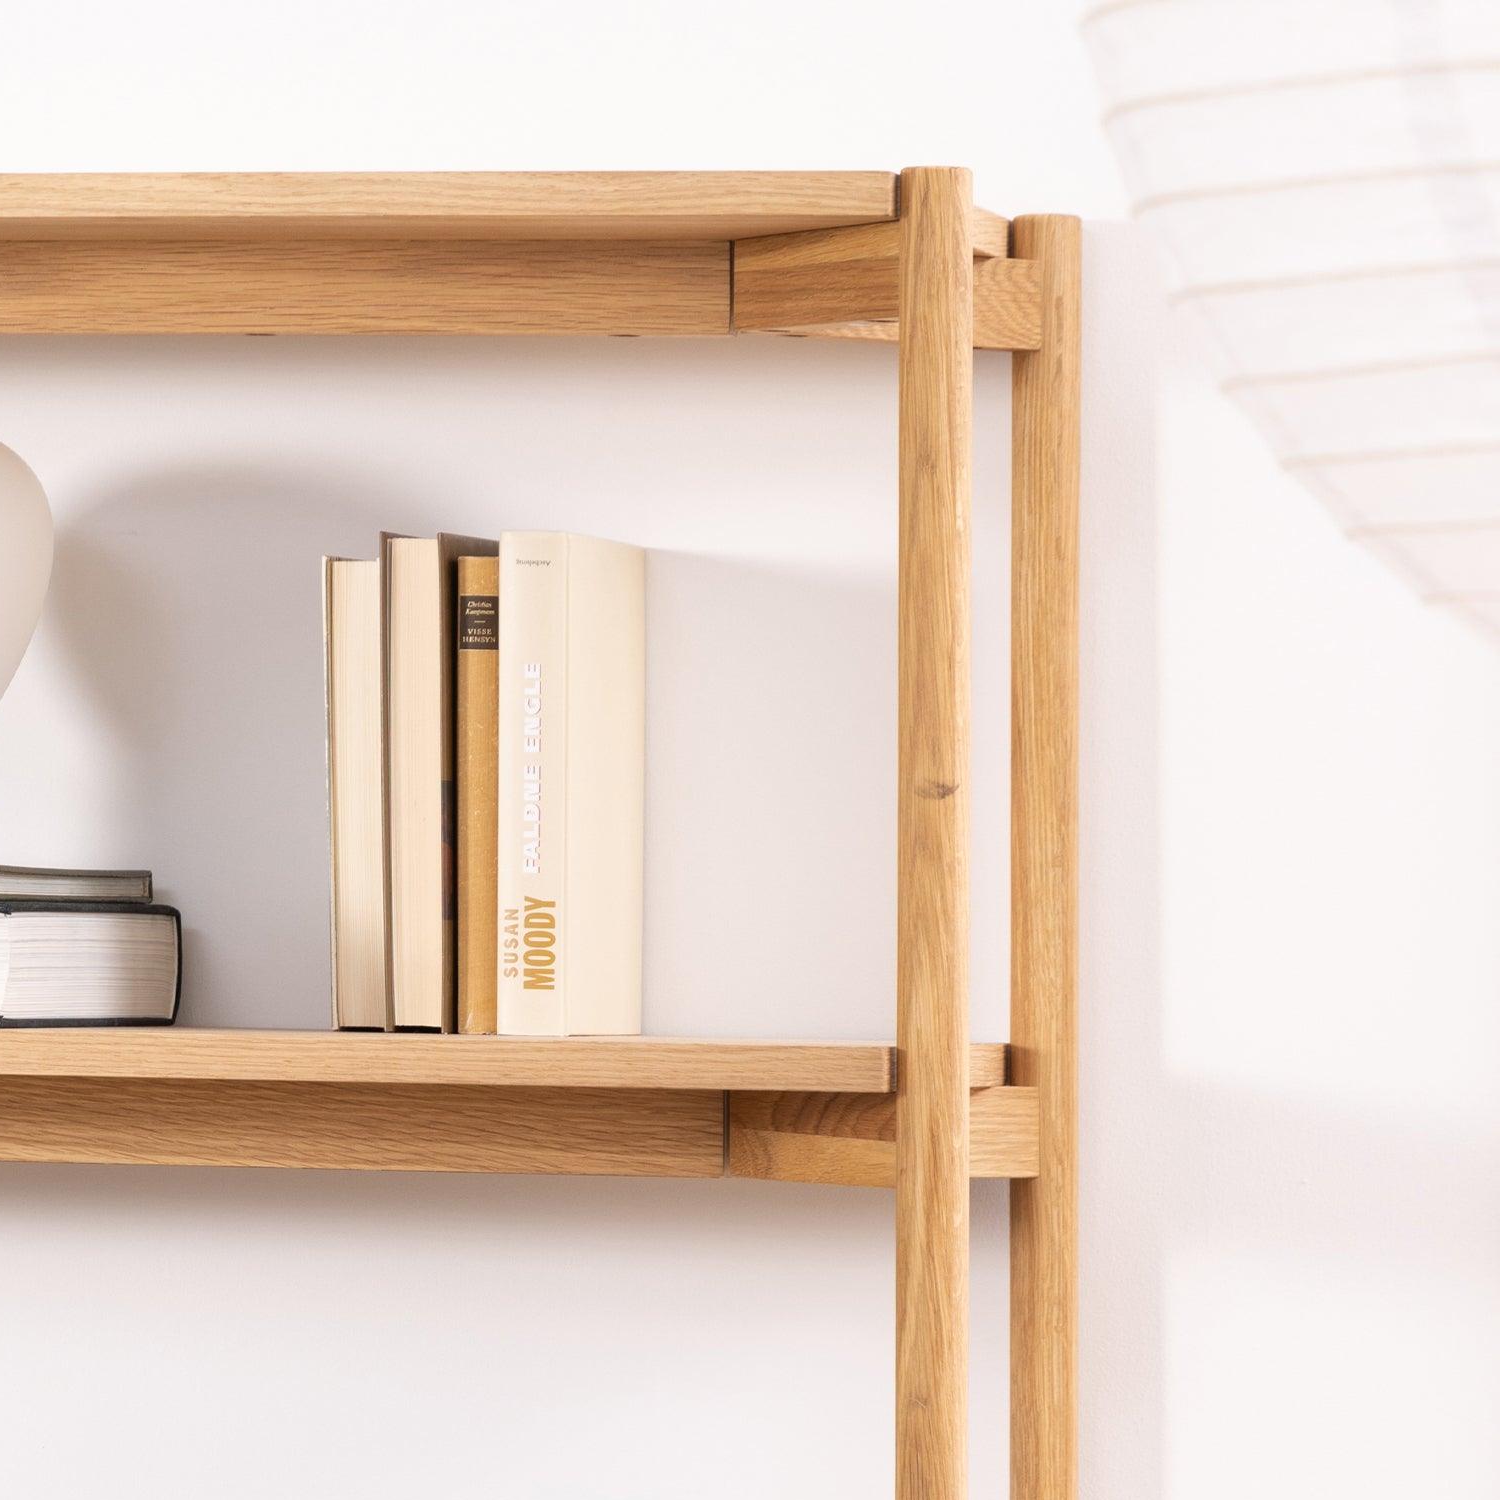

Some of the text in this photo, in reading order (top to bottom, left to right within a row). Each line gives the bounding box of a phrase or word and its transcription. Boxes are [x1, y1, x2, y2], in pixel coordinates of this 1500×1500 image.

[523, 664, 542, 874] FALDNE ENGLE
[504, 908, 519, 978] SUSAN
[523, 896, 556, 990] MOODY
